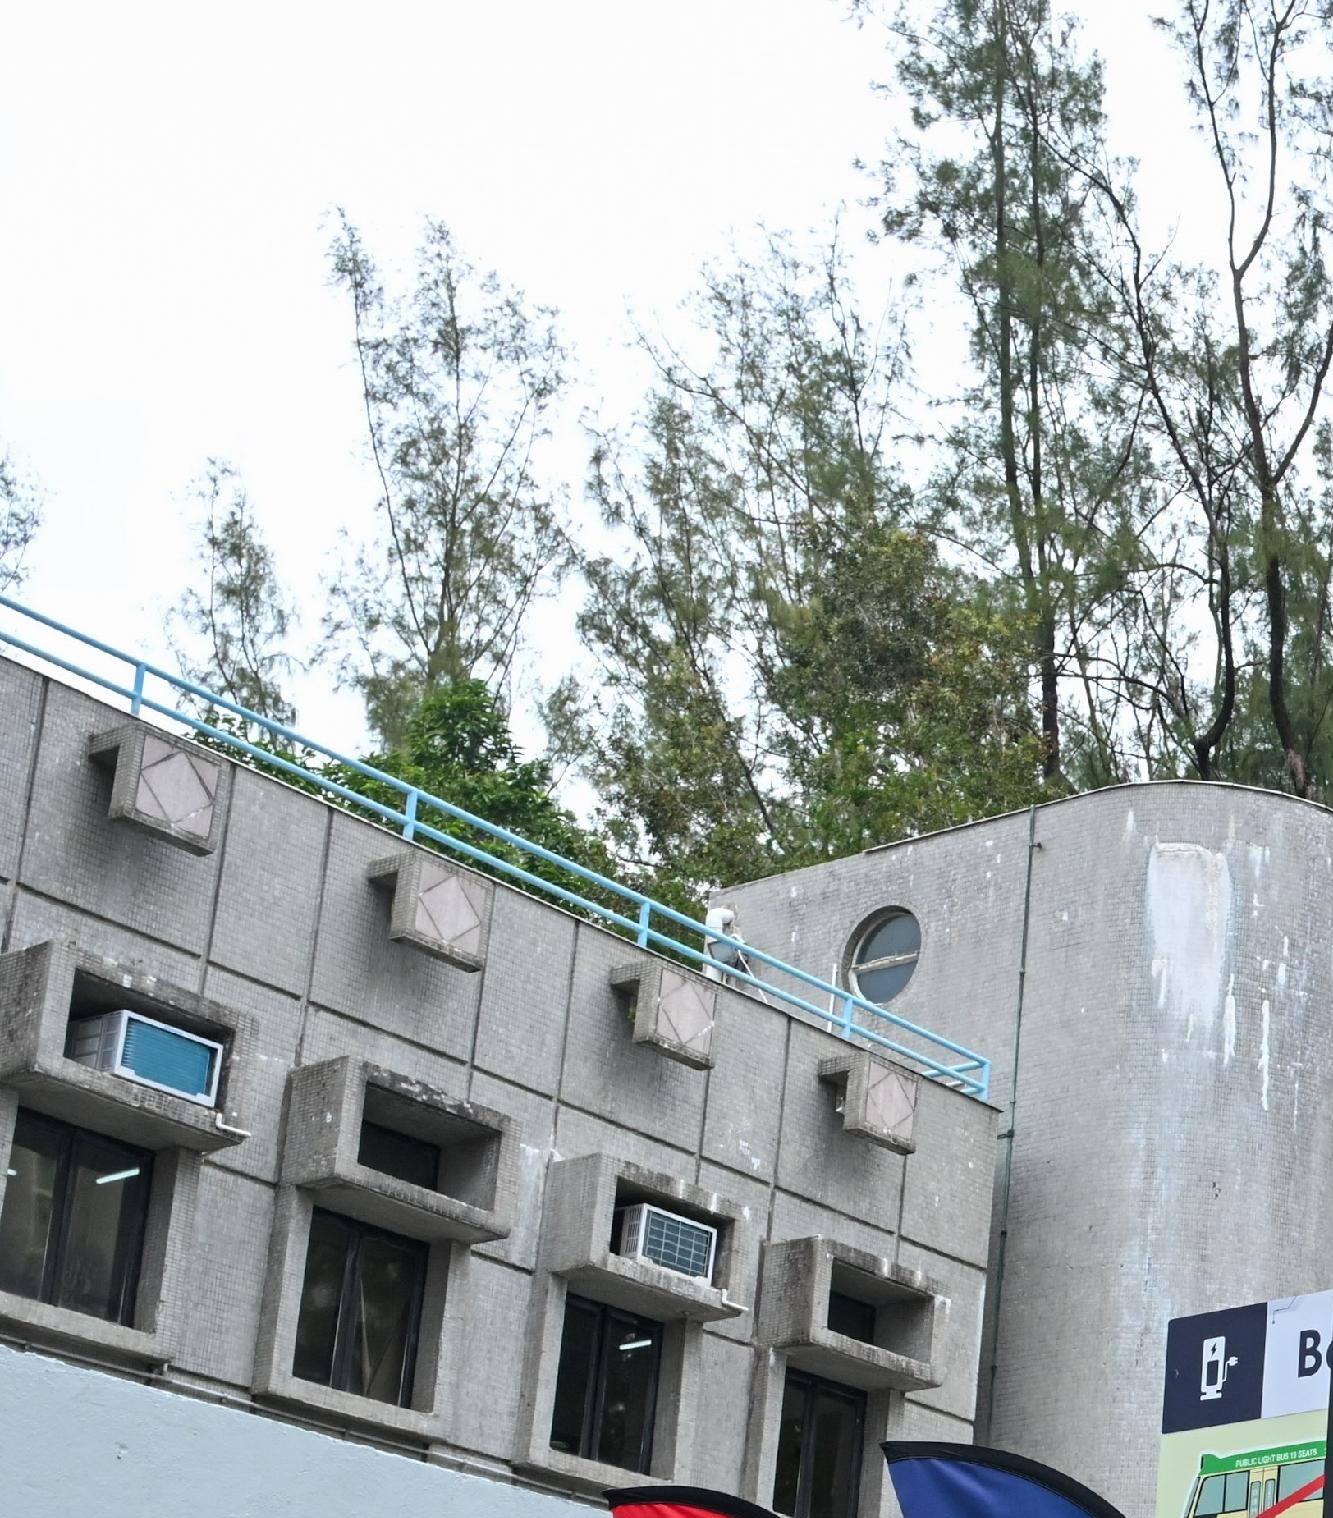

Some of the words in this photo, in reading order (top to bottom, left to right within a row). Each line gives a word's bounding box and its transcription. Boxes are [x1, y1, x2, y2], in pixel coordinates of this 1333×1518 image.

[1235, 1457, 1257, 1468] PUBLIC
[1257, 1455, 1275, 1465] LIGHT
[1276, 1453, 1290, 1462] BUS
[1298, 1448, 1318, 1458] SEATS
